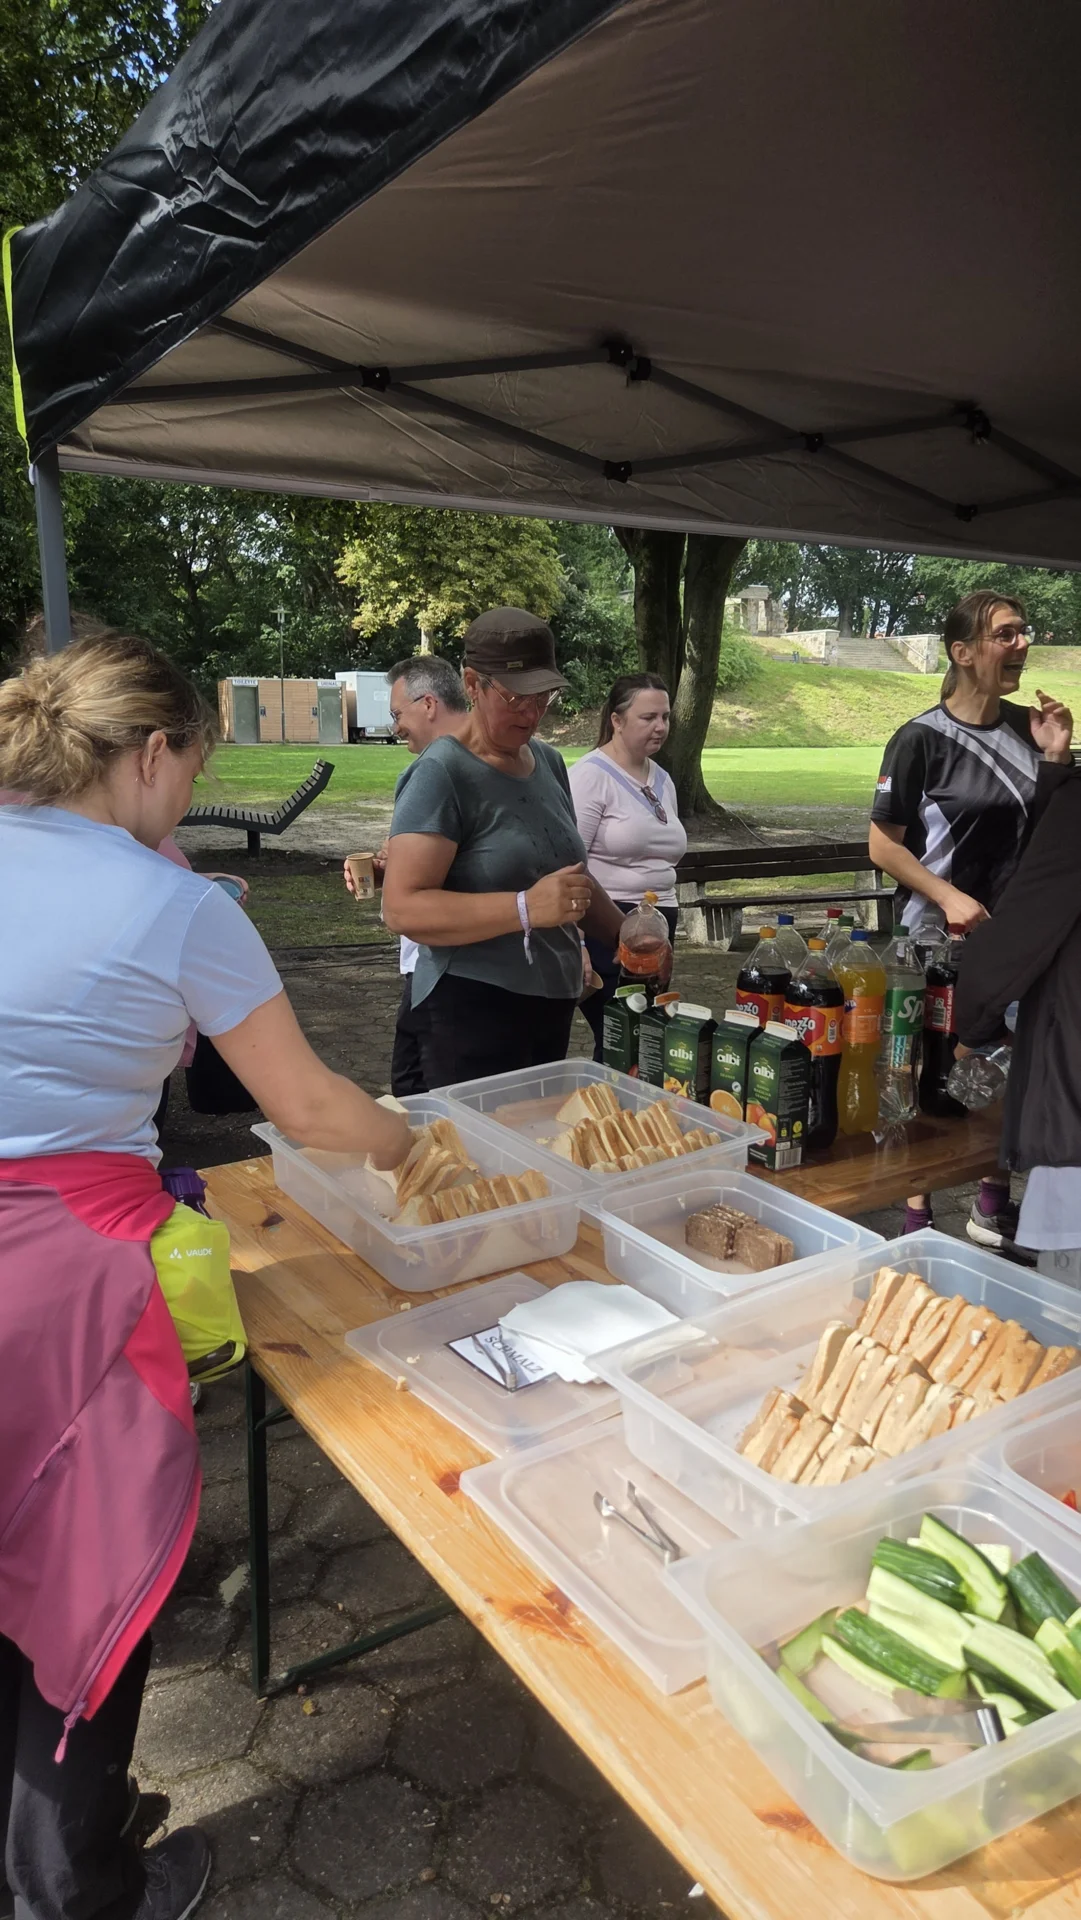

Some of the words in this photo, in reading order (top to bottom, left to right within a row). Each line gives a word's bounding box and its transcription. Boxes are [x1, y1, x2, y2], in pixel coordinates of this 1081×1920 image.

[669, 1048, 694, 1061] albi
[716, 1052, 741, 1066] albi
[753, 1064, 775, 1080] albi
[185, 1248, 213, 1256] VAUDE
[485, 1336, 544, 1374] SCHMALZ
